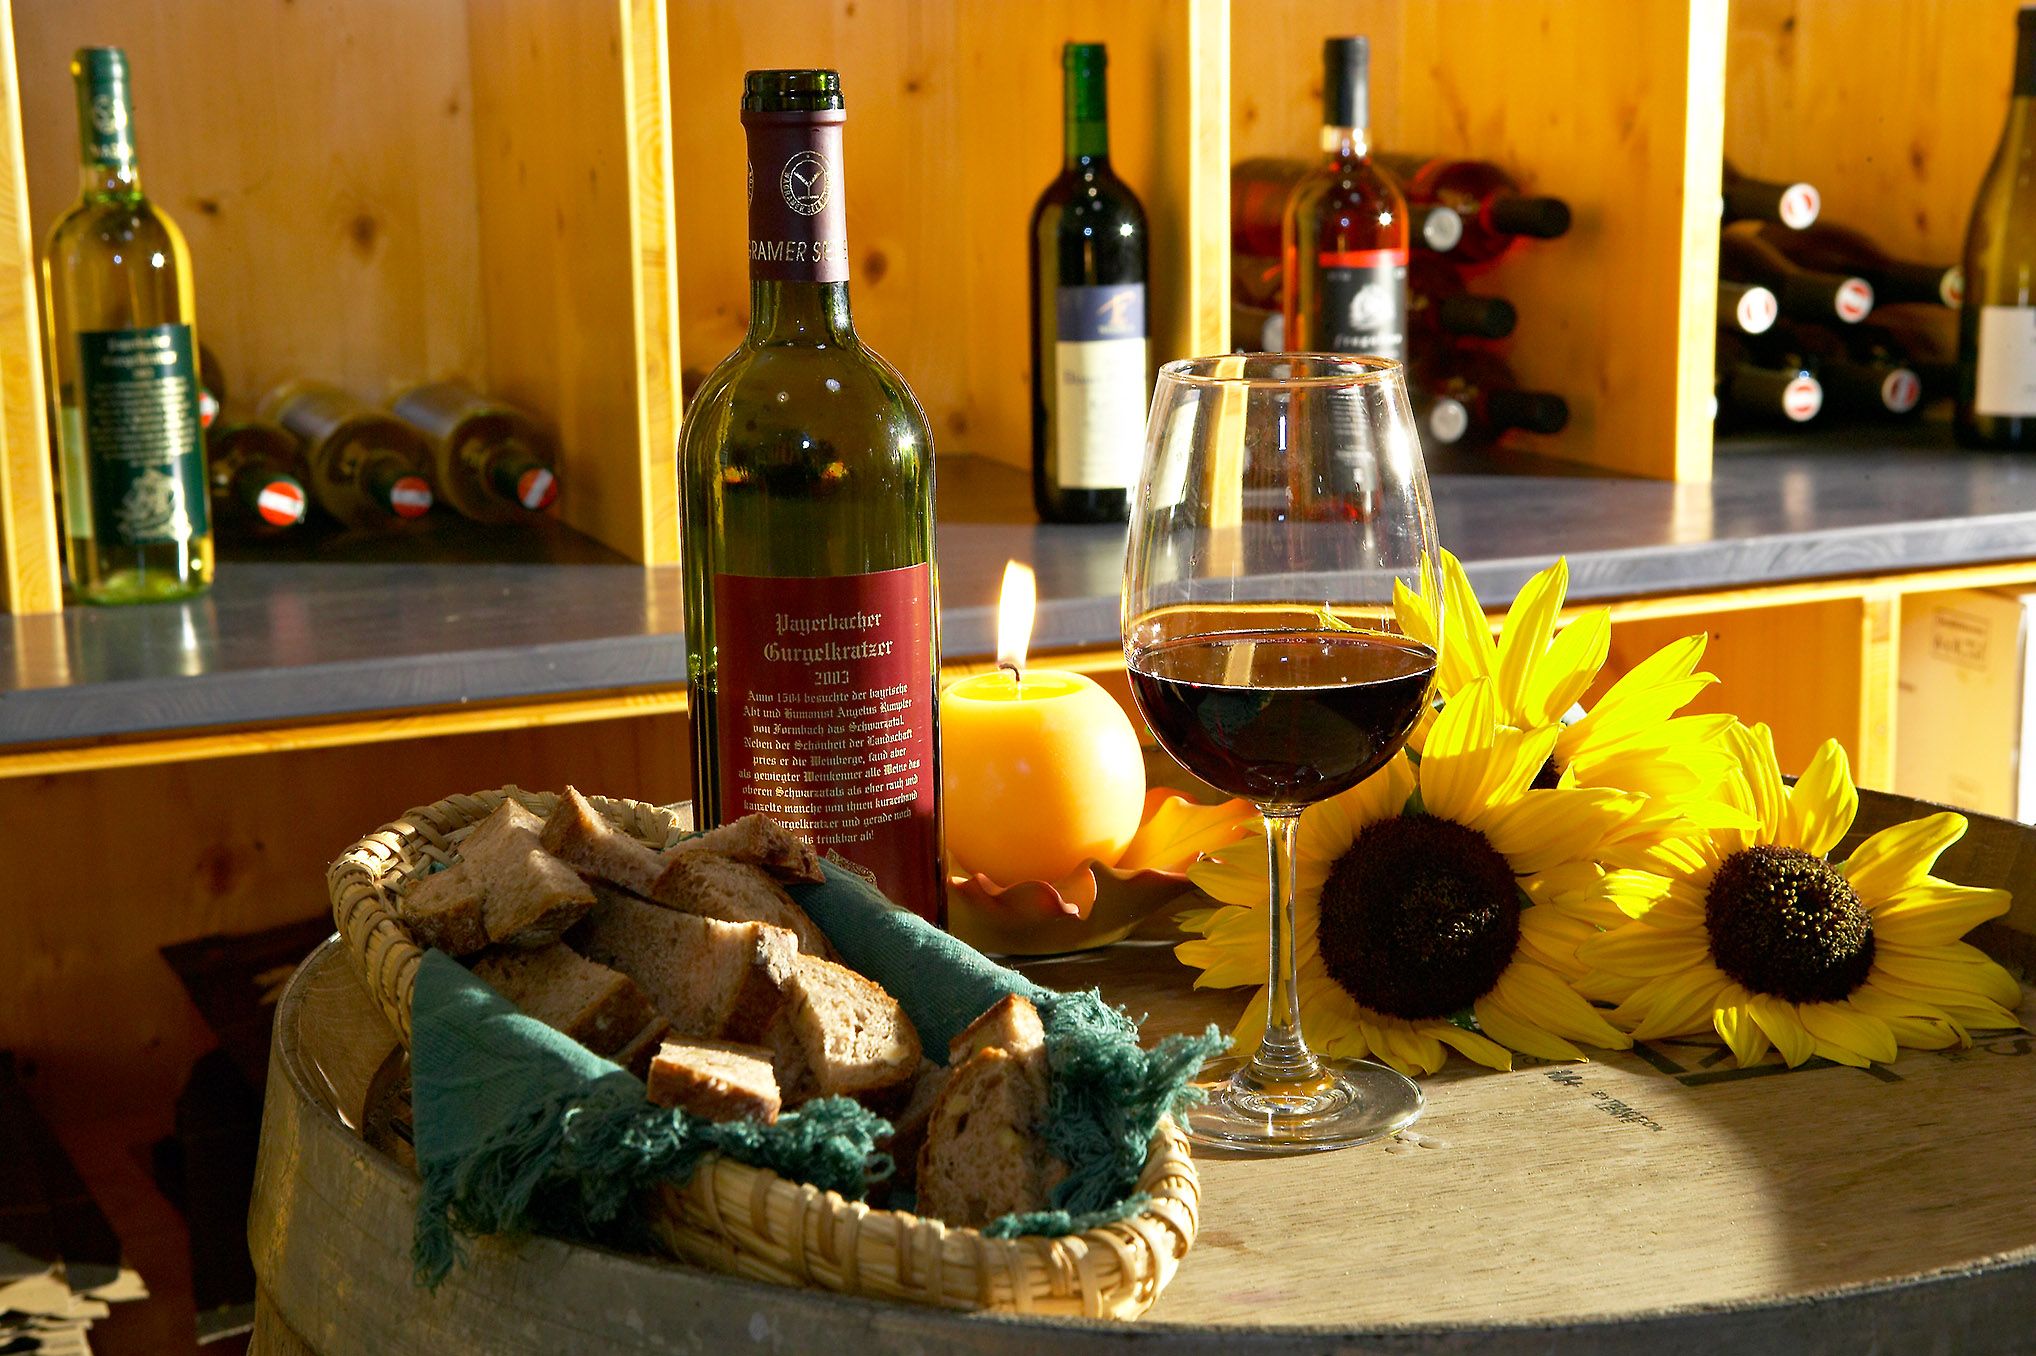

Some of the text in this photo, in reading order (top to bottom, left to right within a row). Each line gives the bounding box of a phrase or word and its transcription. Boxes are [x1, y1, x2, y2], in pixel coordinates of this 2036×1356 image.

[775, 611, 882, 637] Payerbacher
[764, 639, 894, 666] Gurgelkratzer
[814, 670, 850, 686] 2003
[747, 690, 774, 703] Anno
[804, 691, 850, 704] besuchte
[852, 689, 867, 701] der
[743, 706, 762, 718] Abt
[763, 707, 782, 719] und
[753, 723, 771, 735] von
[827, 722, 845, 735] das
[744, 737, 773, 750] Neben
[775, 739, 790, 751] der
[849, 738, 864, 749] der
[752, 755, 777, 767] pries
[779, 757, 789, 766] er
[792, 755, 807, 767] die
[868, 749, 888, 763] fand
[889, 746, 907, 760] aber
[738, 768, 752, 779] als
[754, 770, 801, 784] gewiegter
[864, 766, 882, 779] alle
[742, 786, 773, 798] oberen
[775, 785, 845, 800] Schwarzatals
[847, 785, 863, 796] als
[864, 781, 884, 795] eher
[905, 773, 919, 787] und
[743, 801, 782, 814] kanzelte
[784, 803, 823, 816] manche
[825, 803, 844, 814] von
[846, 800, 874, 815] ihnen
[842, 816, 861, 829] und
[863, 813, 893, 829] gerade
[817, 832, 858, 845] trinkbar
